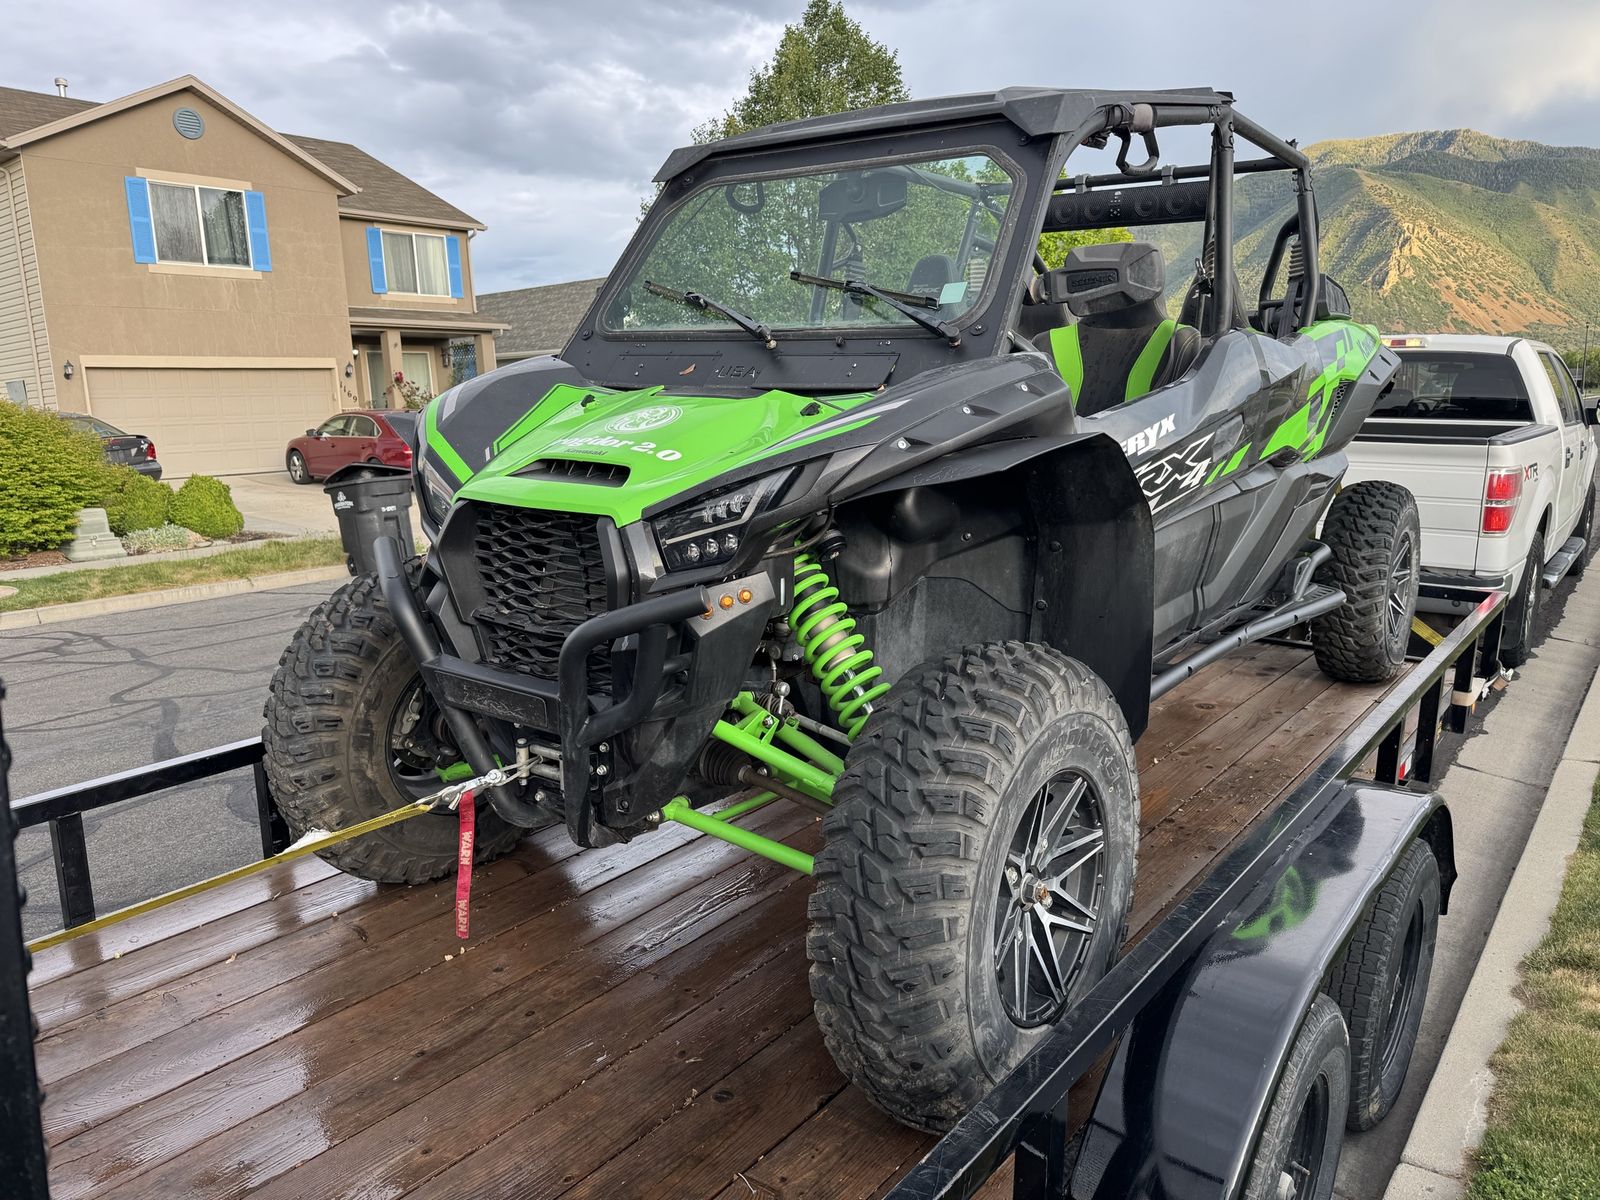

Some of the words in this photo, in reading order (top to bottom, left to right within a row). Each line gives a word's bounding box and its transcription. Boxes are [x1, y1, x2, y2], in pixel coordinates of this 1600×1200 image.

[717, 364, 757, 379] USA
[339, 380, 358, 403] 1169
[1120, 413, 1176, 458] ERYX
[630, 441, 683, 462] 2.0
[460, 830, 473, 866] WARN
[457, 899, 468, 933] WARN
